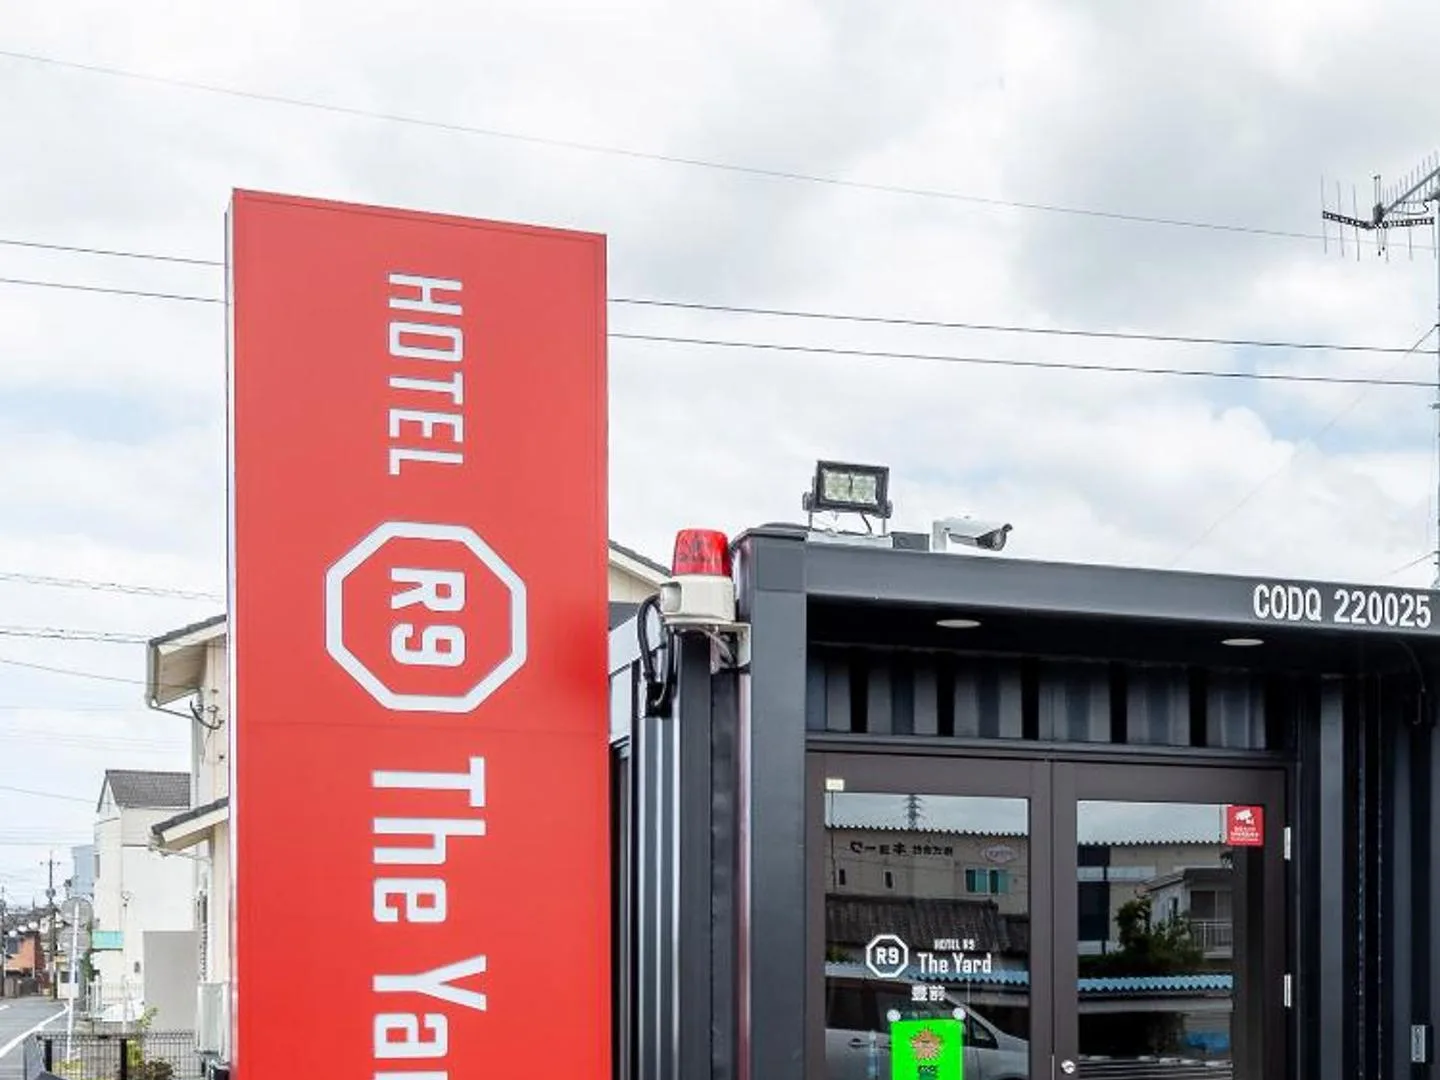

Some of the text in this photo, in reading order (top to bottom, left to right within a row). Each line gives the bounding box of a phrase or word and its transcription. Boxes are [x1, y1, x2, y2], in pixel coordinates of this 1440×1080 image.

[388, 272, 464, 476] HOTEL
[390, 567, 466, 668] R9
[1253, 583, 1321, 622] CODQ
[1333, 589, 1432, 628] 220025
[371, 756, 487, 924] The
[875, 946, 900, 965] R9
[917, 952, 992, 974] The Yard
